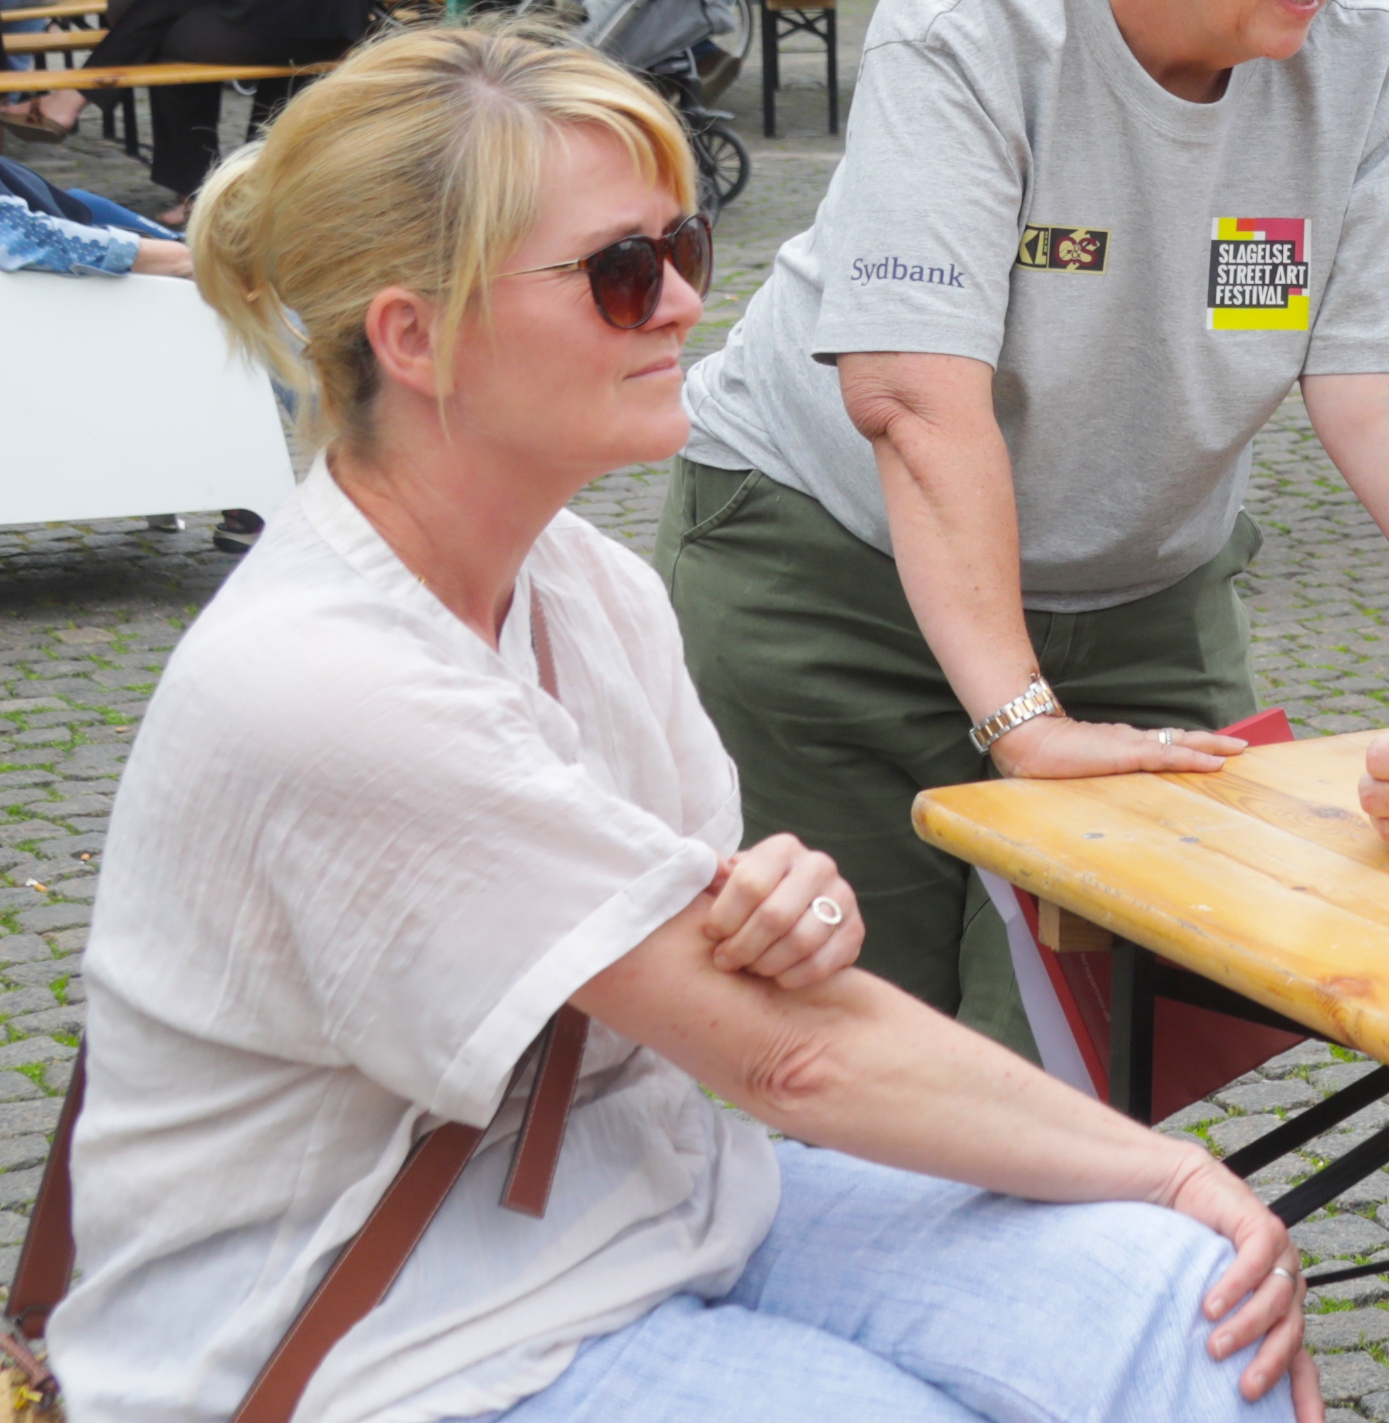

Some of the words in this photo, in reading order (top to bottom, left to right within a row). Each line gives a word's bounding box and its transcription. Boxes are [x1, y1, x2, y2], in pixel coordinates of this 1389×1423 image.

[1218, 243, 1293, 264] SLAGELSE
[849, 256, 966, 289] Sydbank
[1217, 264, 1273, 285] STREET
[1274, 265, 1307, 286] ART
[1214, 285, 1285, 306] FESTIVAL
